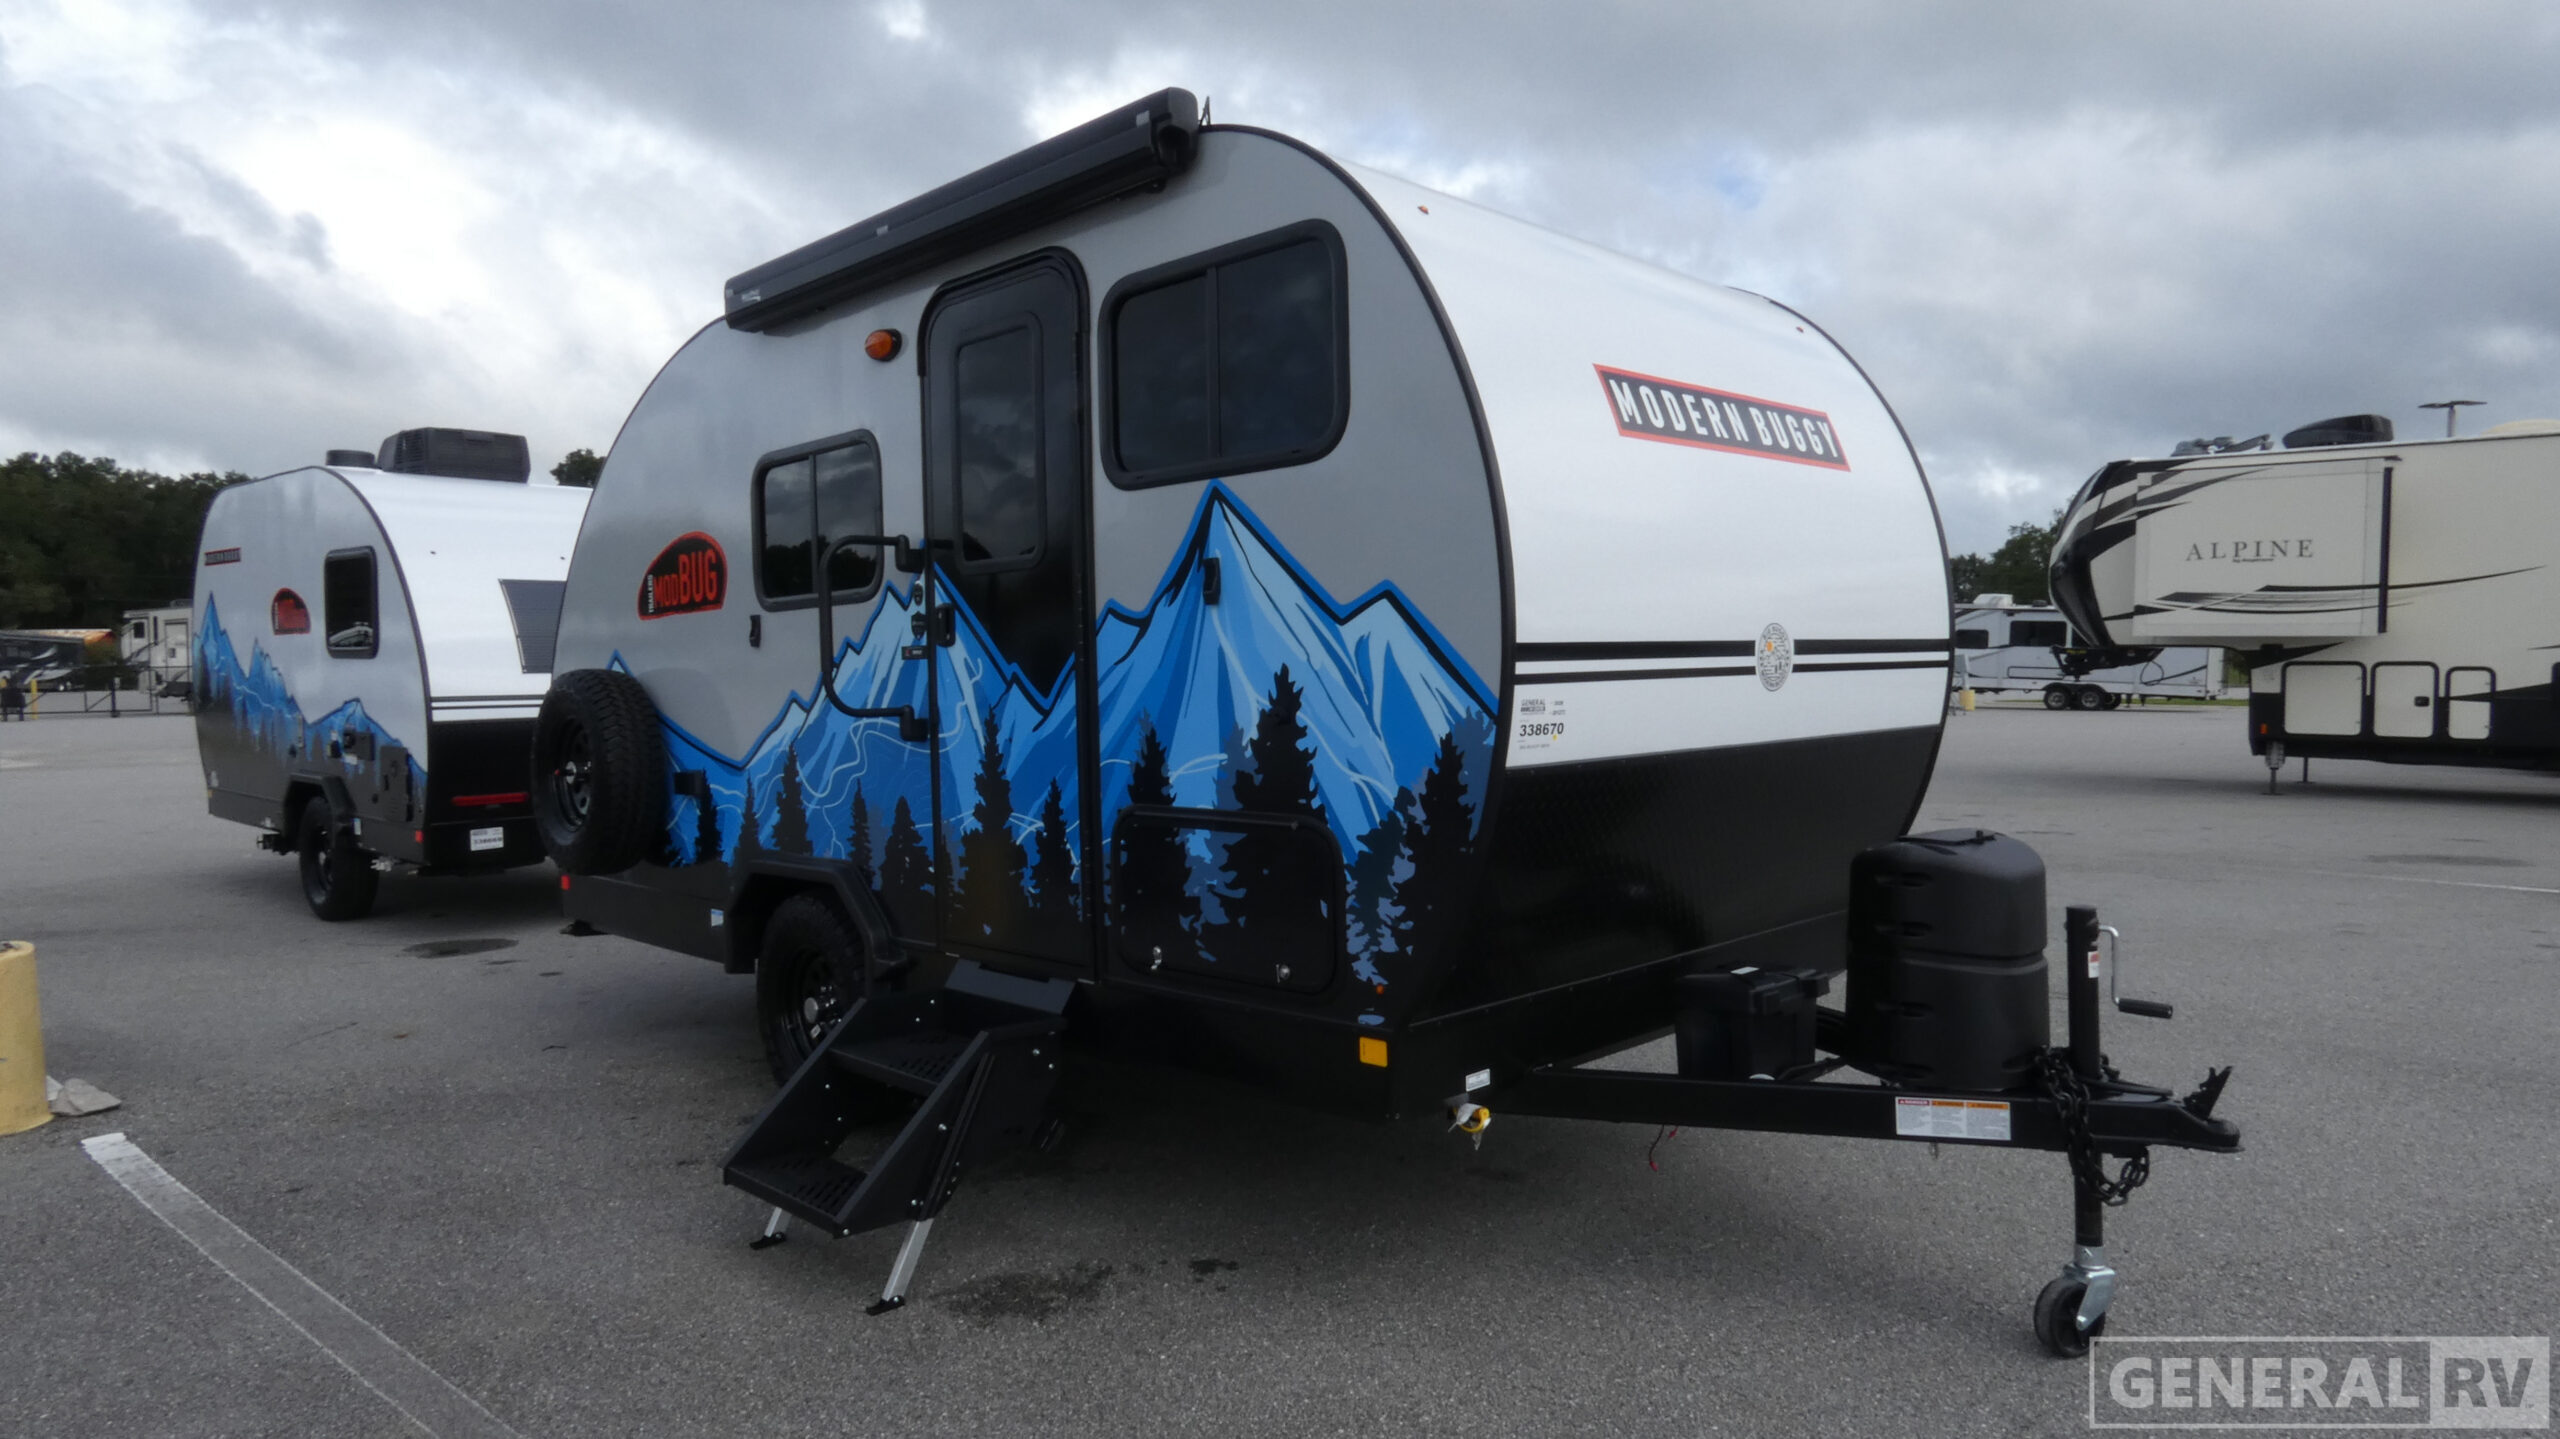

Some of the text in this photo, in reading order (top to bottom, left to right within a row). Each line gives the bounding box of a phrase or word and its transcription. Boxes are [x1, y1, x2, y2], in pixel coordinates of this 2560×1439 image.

[1608, 378, 1839, 458] MODERN BUGGY
[2185, 539, 2314, 562] ALPINE
[1519, 722, 1565, 737] 338670
